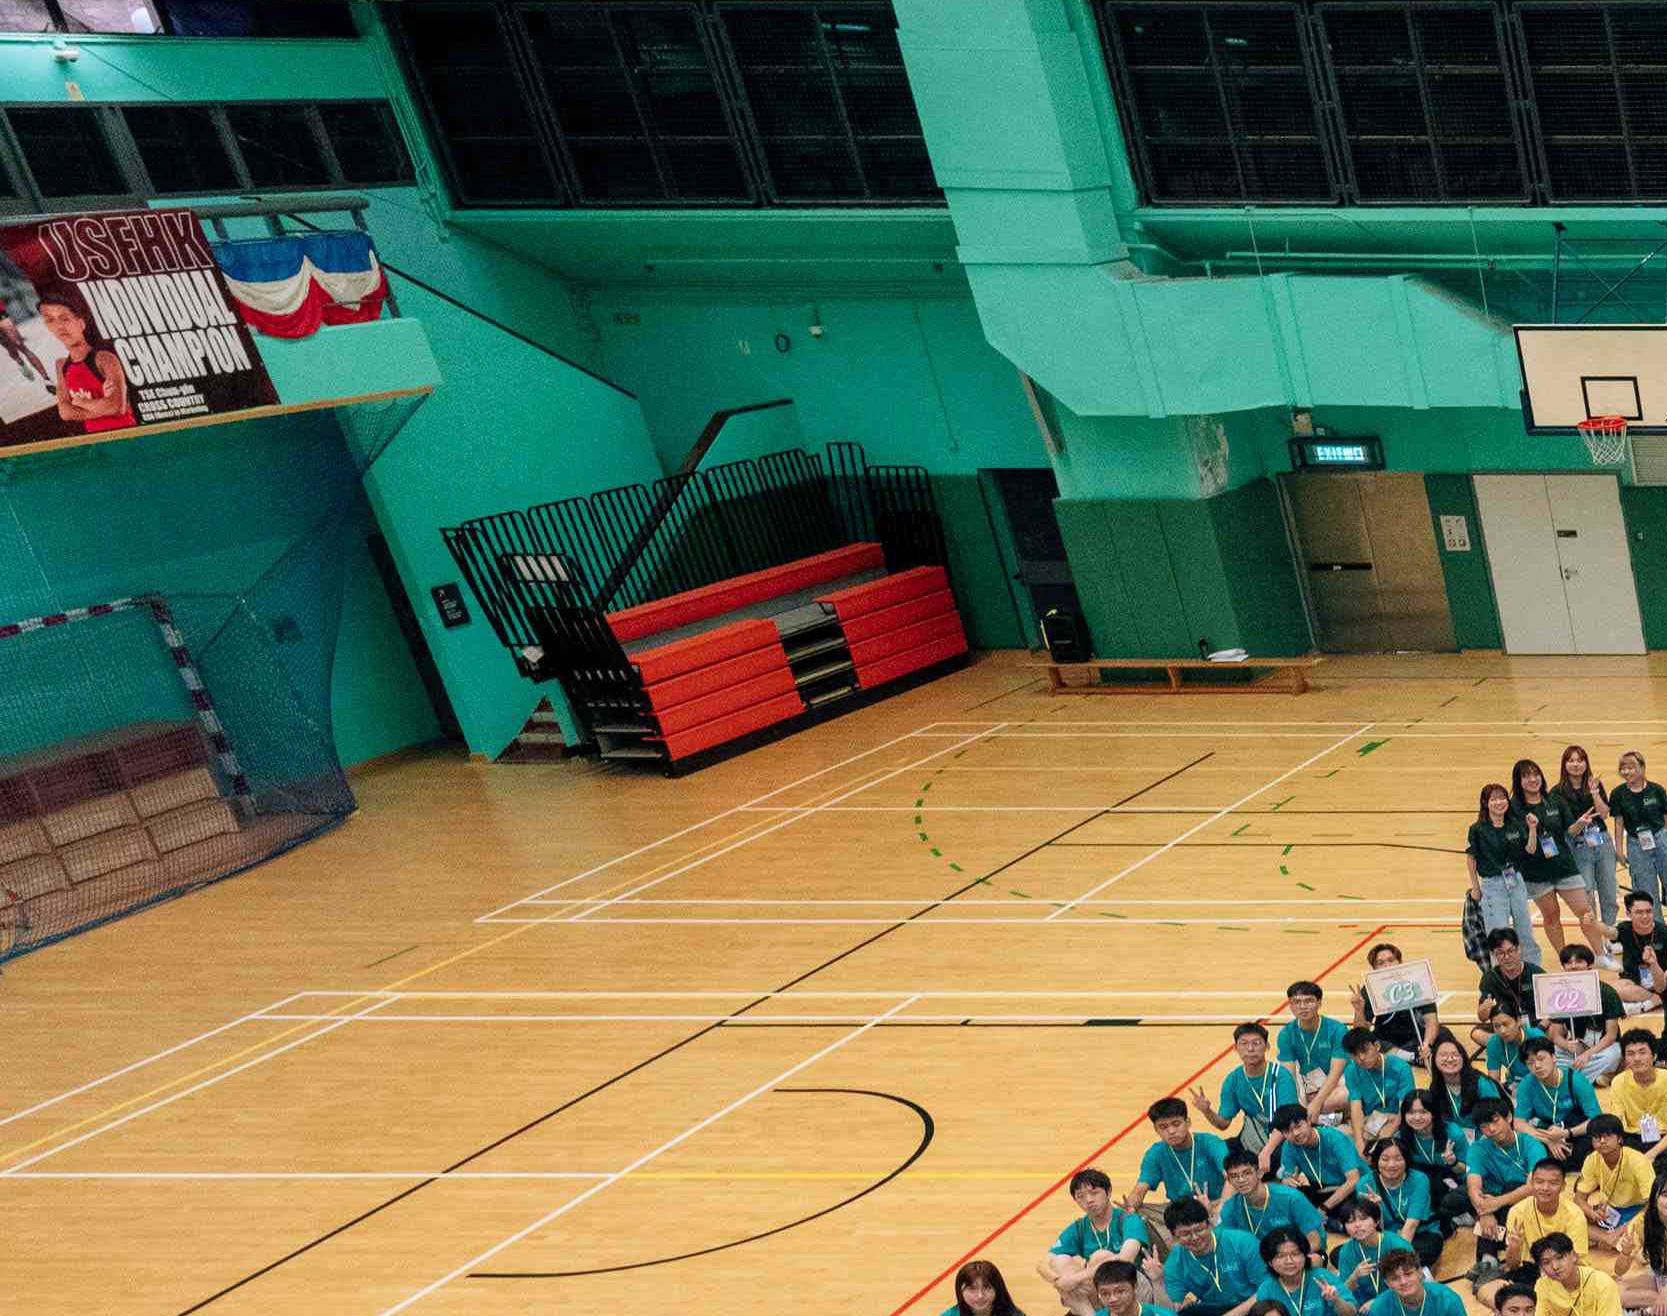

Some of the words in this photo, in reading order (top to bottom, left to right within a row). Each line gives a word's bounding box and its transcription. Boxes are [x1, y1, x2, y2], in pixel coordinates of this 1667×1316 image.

[39, 211, 215, 282] USFHK
[76, 270, 238, 340] INDIVIDUAL
[113, 324, 252, 387] CHAMPION
[1390, 980, 1415, 1004] C3
[1554, 989, 1580, 1010] C2
